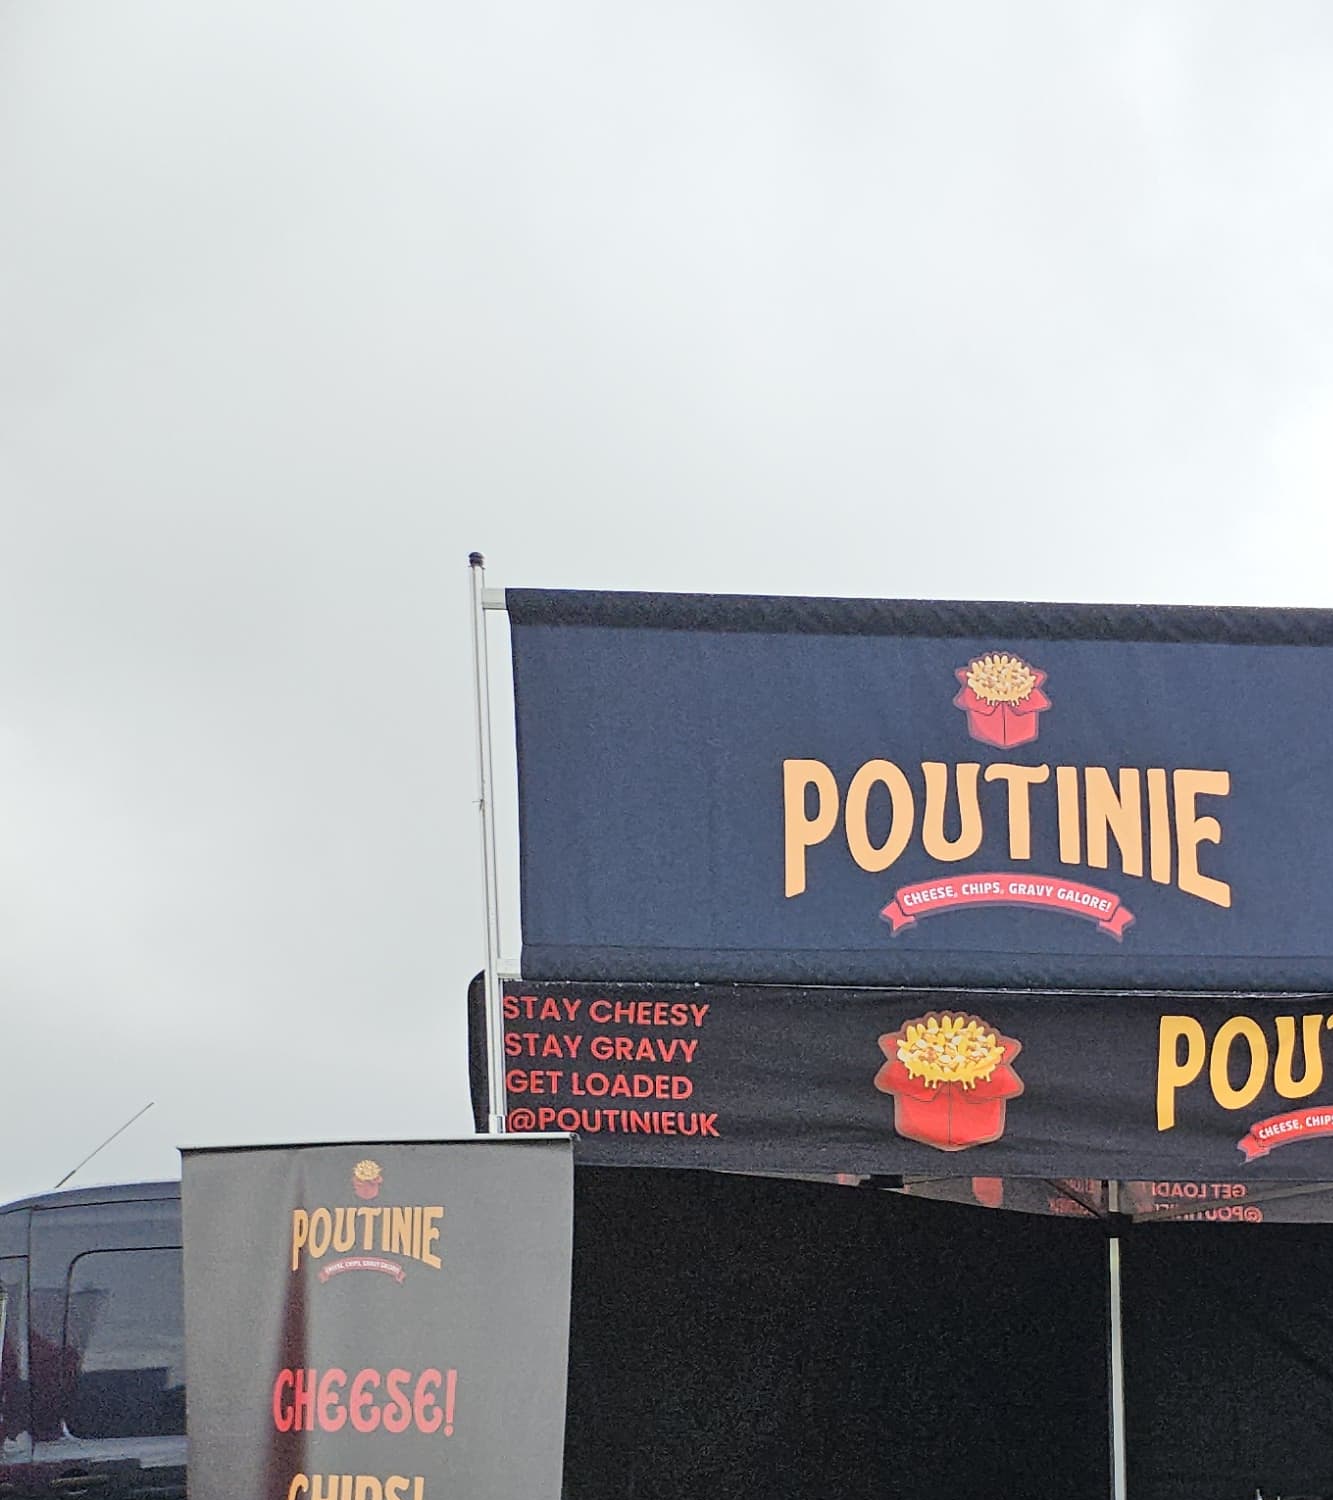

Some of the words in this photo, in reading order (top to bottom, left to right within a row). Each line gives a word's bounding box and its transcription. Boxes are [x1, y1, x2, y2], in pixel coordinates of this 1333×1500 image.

[783, 758, 1232, 908] POUTINIE
[903, 884, 958, 906] CHEESE,
[1009, 883, 1053, 897] GRAVY
[1057, 888, 1112, 912] GALORE!
[503, 996, 581, 1022] STAY
[589, 1000, 709, 1028] CHEESY
[504, 1032, 583, 1058] STAY
[591, 1036, 698, 1063] GRAVY
[506, 1069, 563, 1094] GET
[571, 1072, 693, 1100] LOADED
[508, 1107, 720, 1137] @POUTINIEUK
[1259, 1120, 1303, 1140] CHEESE,
[292, 1206, 444, 1271] POUTINIE
[272, 1367, 458, 1437] CHEESE!
